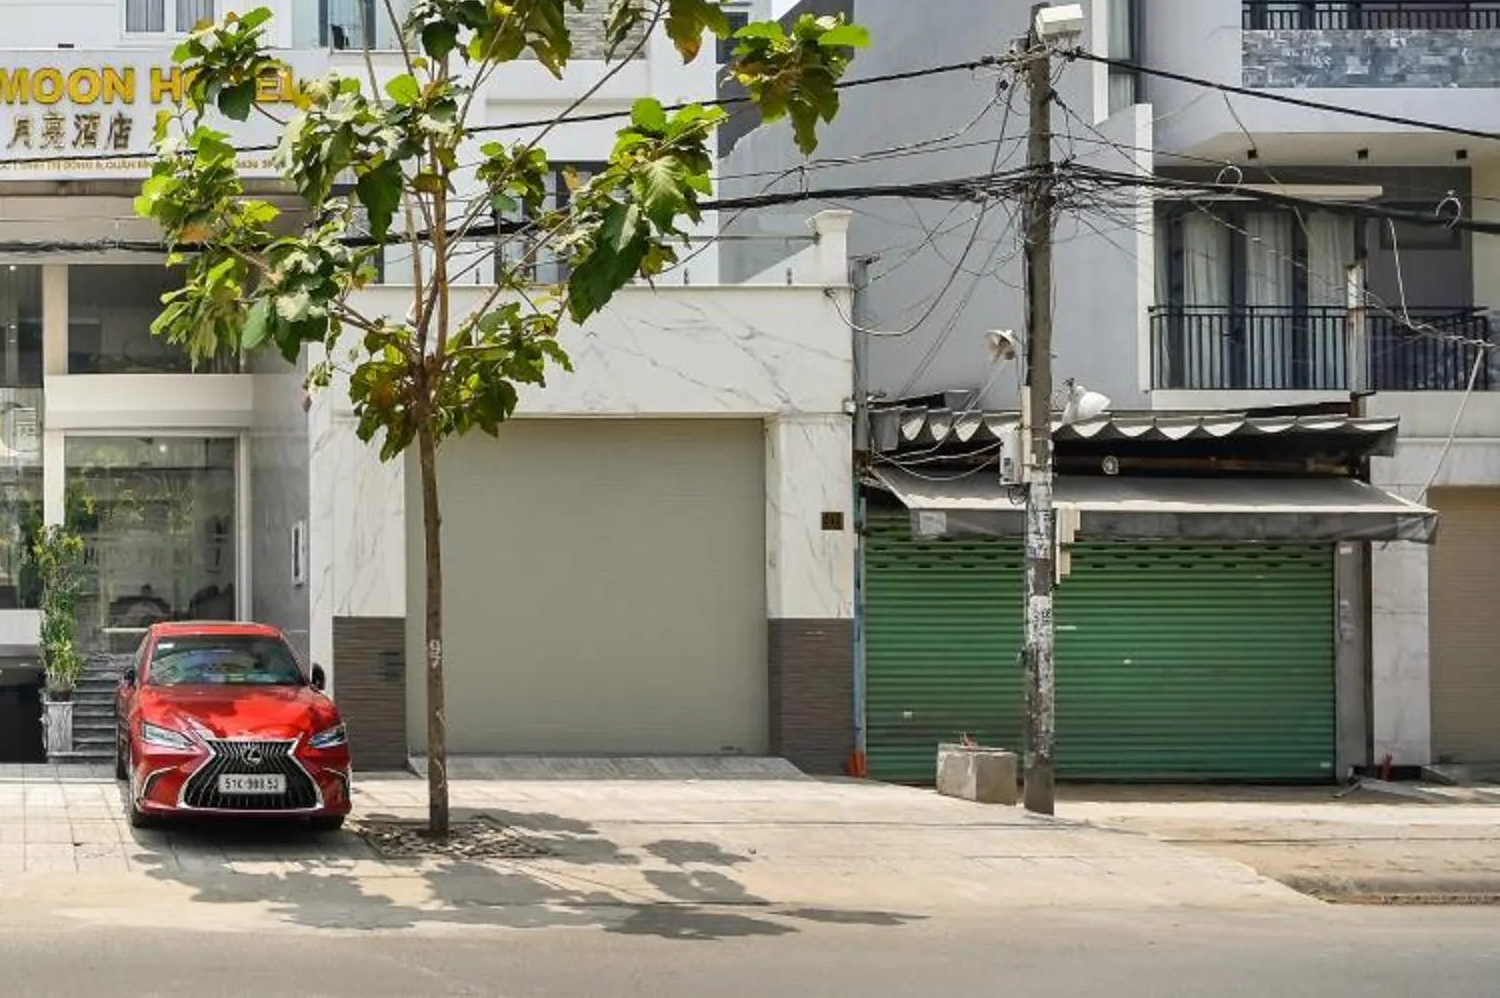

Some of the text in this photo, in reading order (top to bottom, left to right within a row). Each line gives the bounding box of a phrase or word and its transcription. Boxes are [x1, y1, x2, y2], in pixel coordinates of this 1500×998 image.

[150, 66, 300, 104] HEL
[7, 110, 133, 151] 月亮酒店
